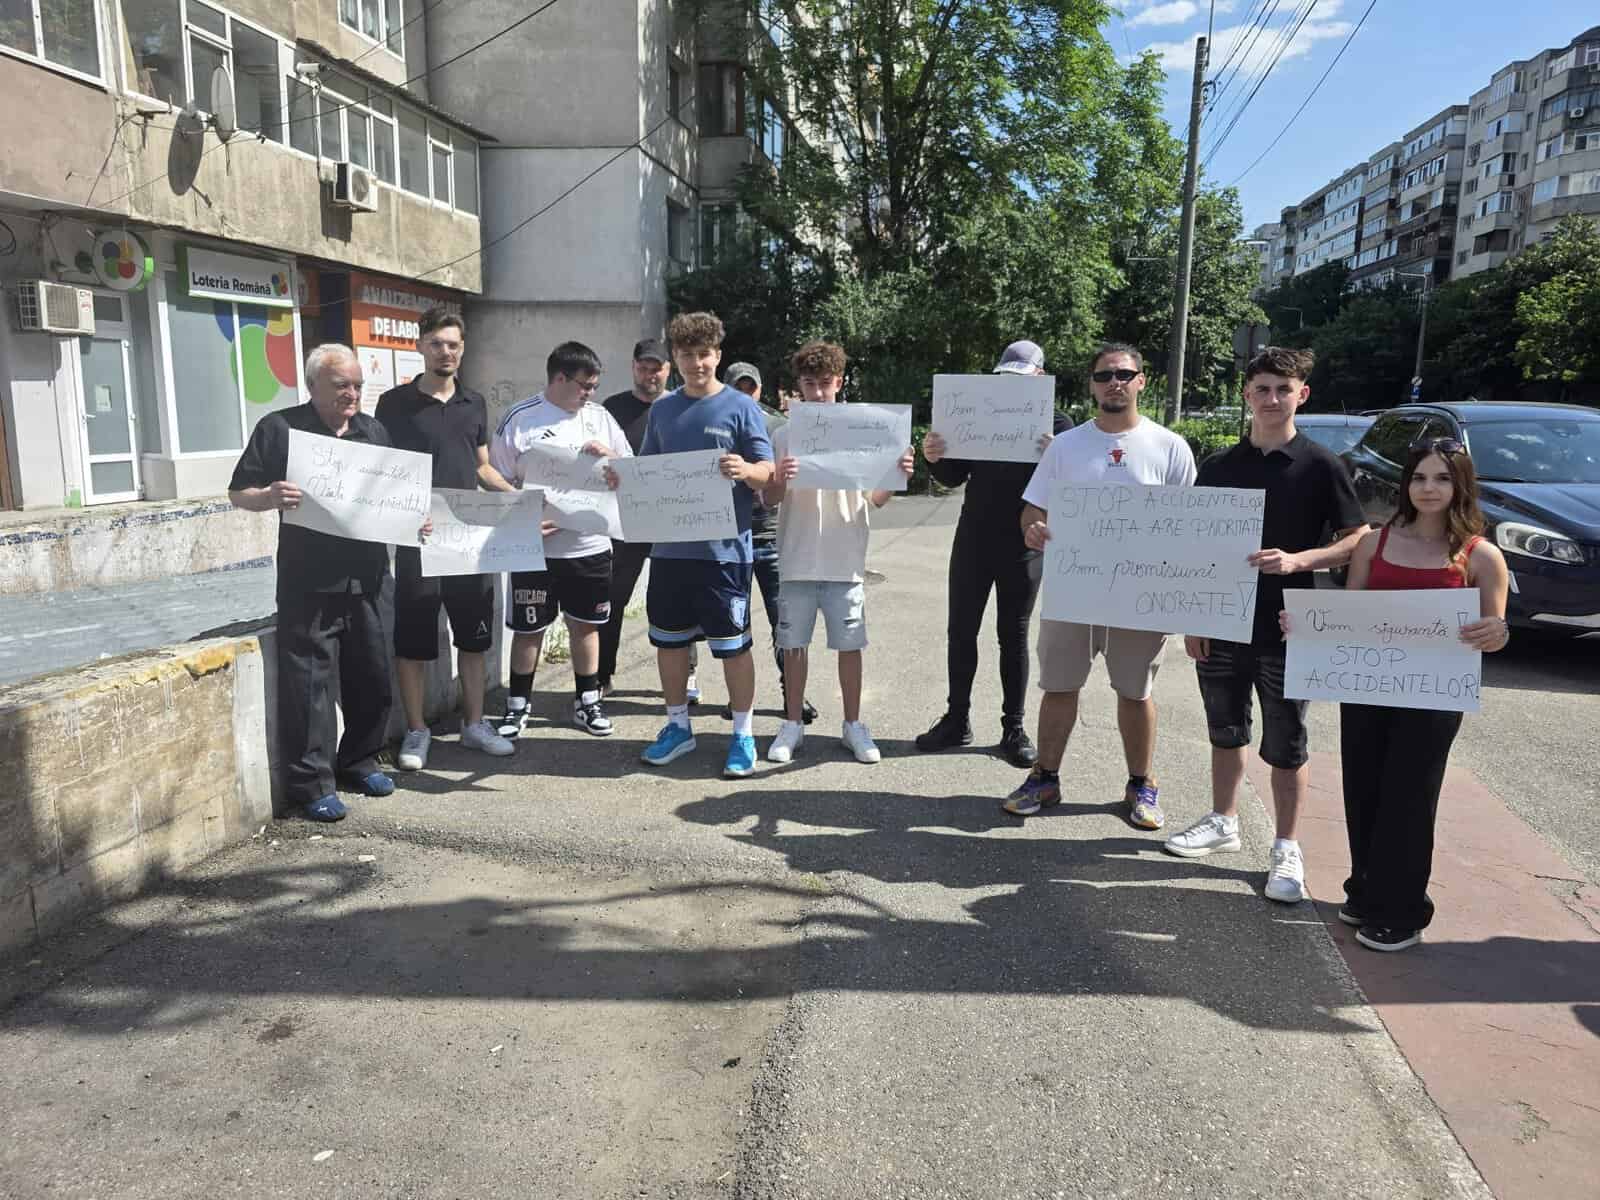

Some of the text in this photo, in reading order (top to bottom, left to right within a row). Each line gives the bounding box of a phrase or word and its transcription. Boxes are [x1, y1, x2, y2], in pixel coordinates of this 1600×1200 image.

[191, 271, 272, 296] Loteria Română
[374, 316, 420, 340] DE LABO
[1061, 486, 1263, 519] STOP ACCIDENTELOR
[1149, 518, 1184, 537] ARE
[1056, 548, 1218, 592] Vrem promisiuni
[514, 588, 547, 605] CHICAGO
[1135, 590, 1237, 617] ONORATE
[526, 605, 537, 625] 8
[1305, 608, 1355, 633] Vrem
[1329, 645, 1408, 669] STOP
